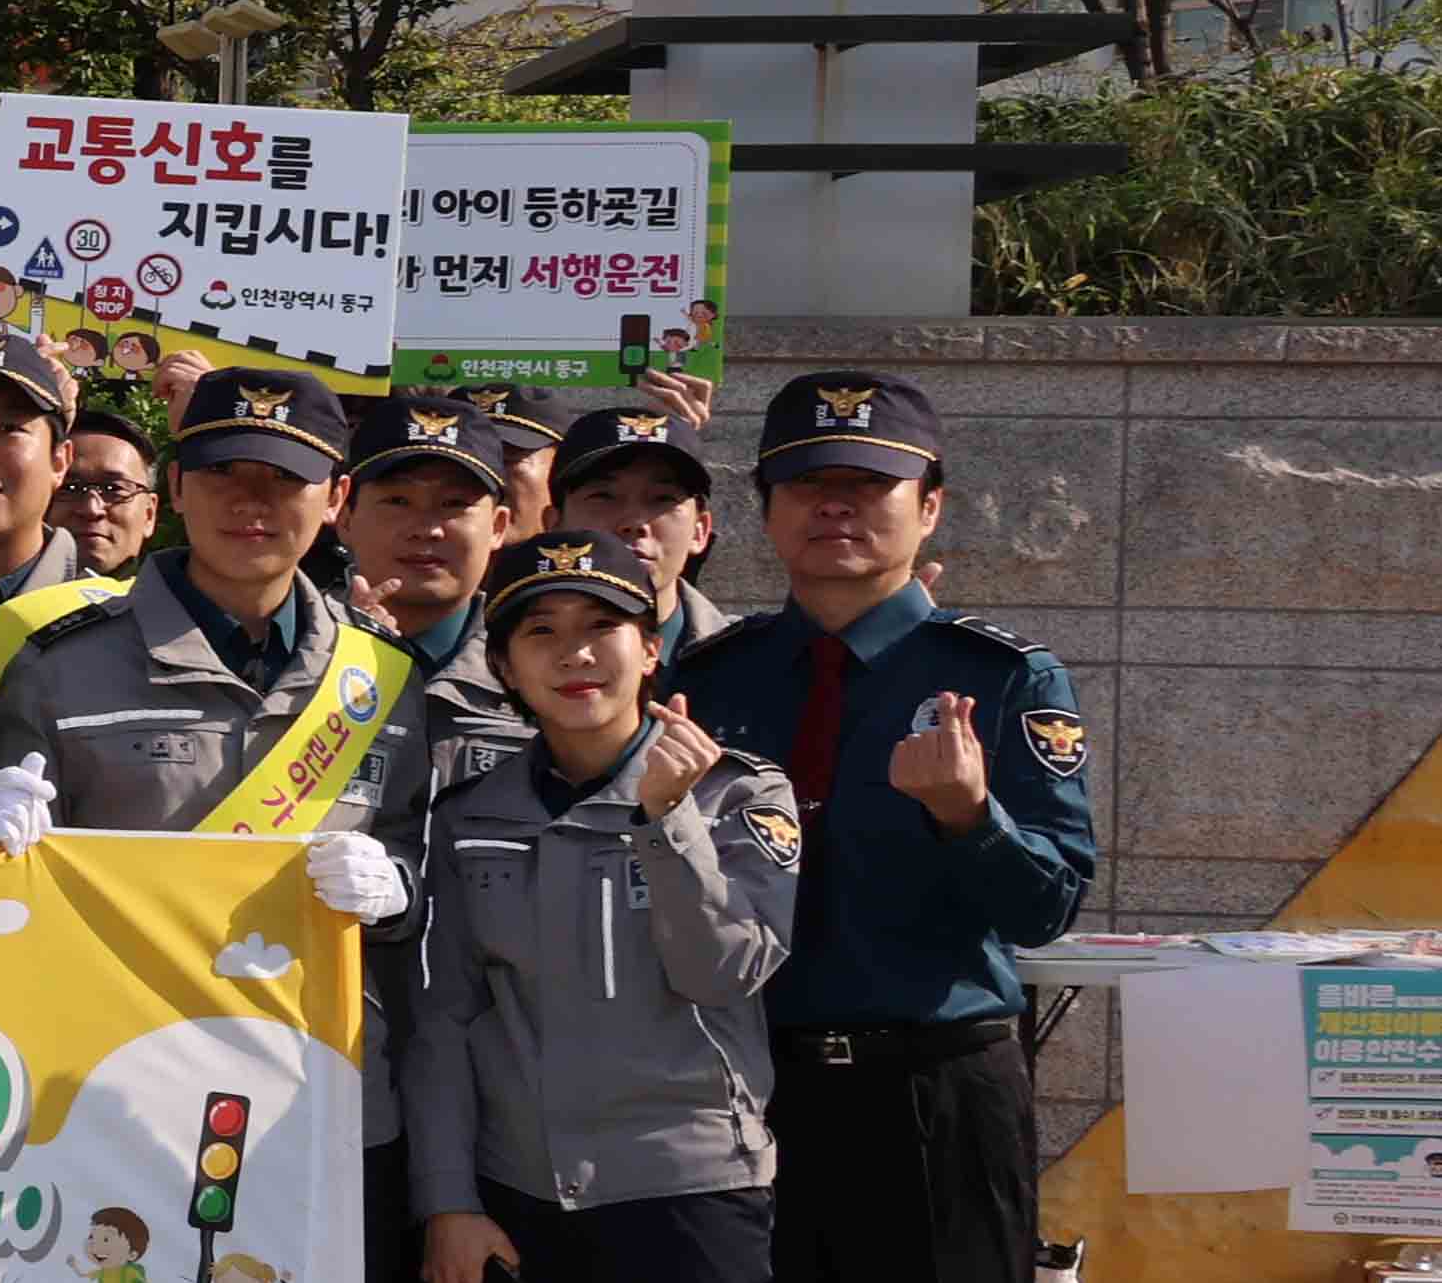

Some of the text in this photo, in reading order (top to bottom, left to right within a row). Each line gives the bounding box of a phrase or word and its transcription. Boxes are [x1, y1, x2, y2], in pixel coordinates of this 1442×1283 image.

[18, 115, 313, 191] 교통신호를
[432, 188, 511, 222] 아이
[523, 186, 679, 229] 등하굣길
[76, 229, 100, 248] 30
[158, 201, 391, 260] 지킵시다!
[433, 254, 509, 293] 먼저
[521, 253, 680, 296] 서행운전
[94, 301, 125, 314] STOP
[241, 286, 374, 314] 인천광역시 동구
[460, 359, 589, 378] 인천광역시 동구
[261, 711, 350, 829] 어린이가
